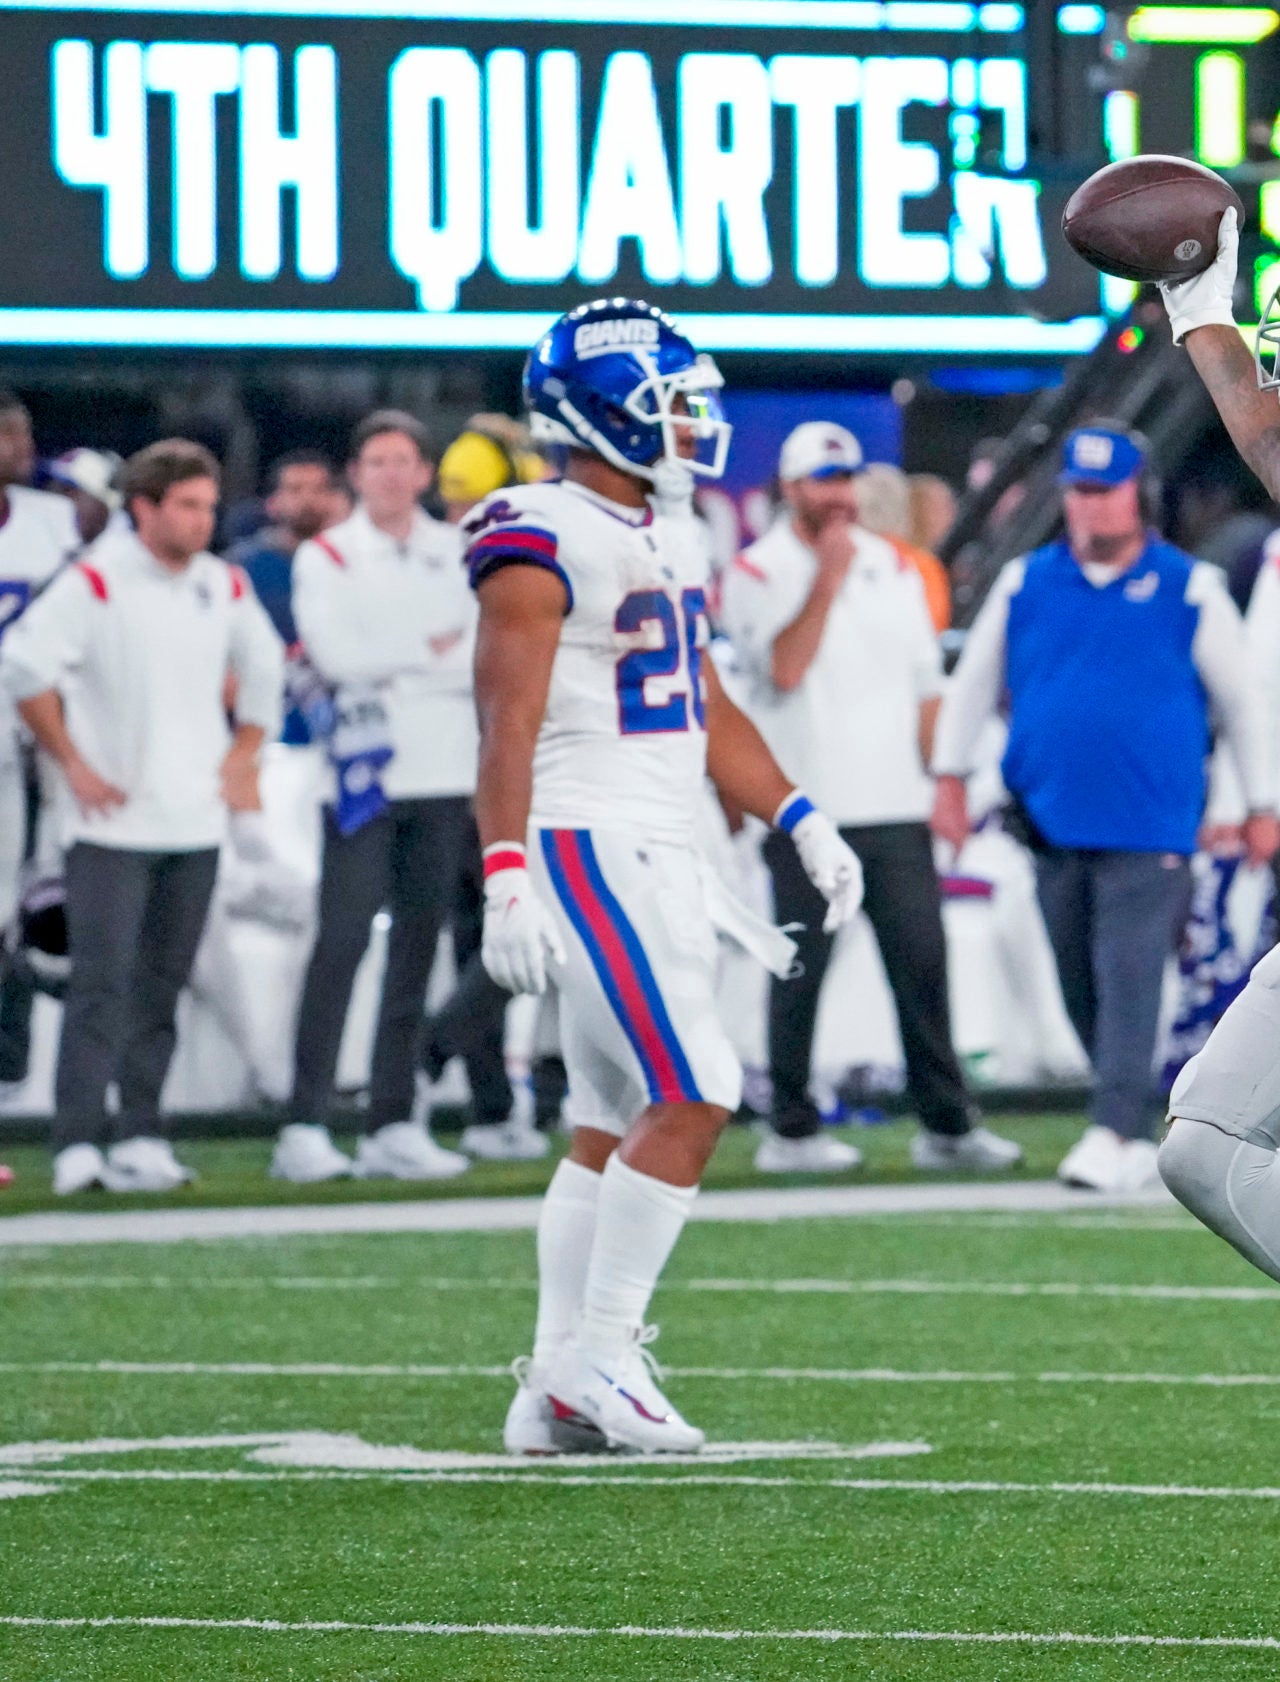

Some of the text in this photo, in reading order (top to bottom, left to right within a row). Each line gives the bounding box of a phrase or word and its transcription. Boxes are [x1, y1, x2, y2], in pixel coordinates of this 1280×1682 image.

[51, 39, 339, 280] 4TH
[389, 46, 1046, 312] QUARTER
[574, 318, 660, 352] GIANTS
